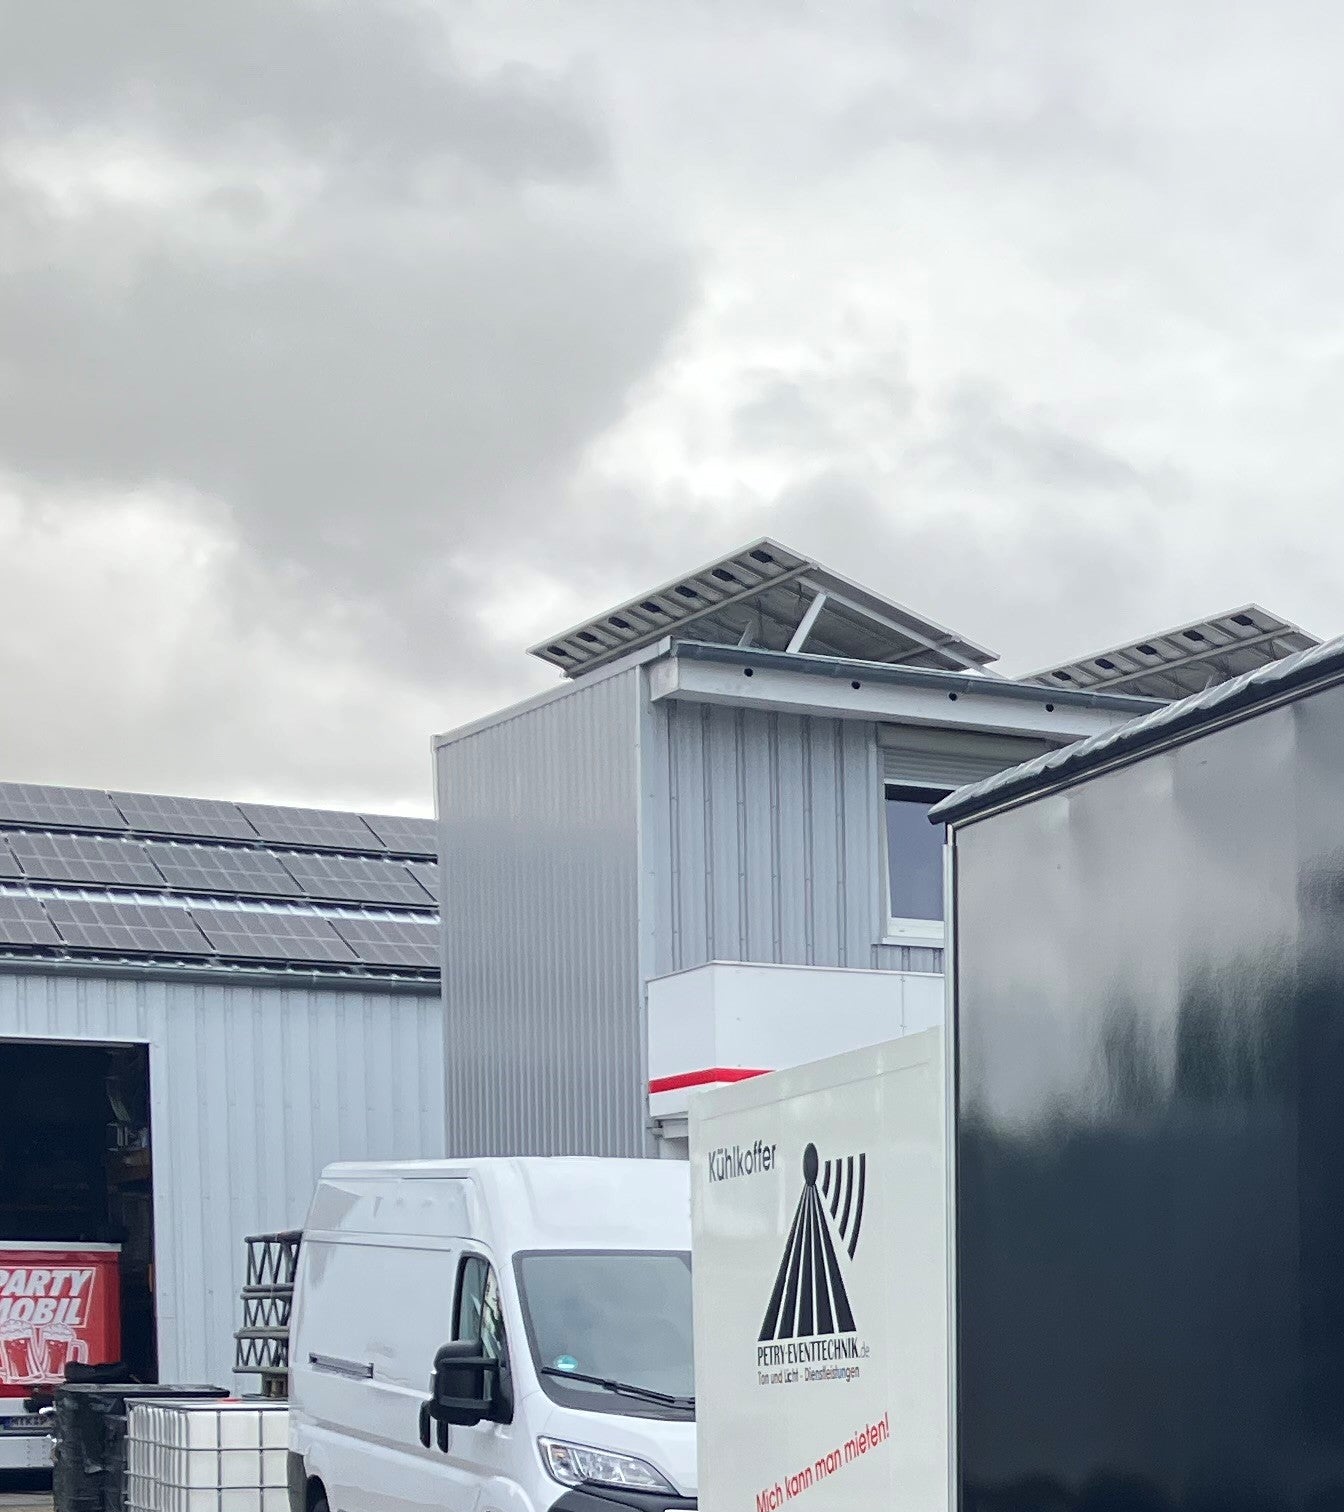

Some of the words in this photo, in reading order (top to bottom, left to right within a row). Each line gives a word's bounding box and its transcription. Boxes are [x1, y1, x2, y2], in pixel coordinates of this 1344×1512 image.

[708, 1139, 777, 1183] Kühlkoffer
[770, 1369, 783, 1384] und
[804, 1364, 860, 1382] Dienstleistungen
[784, 1466, 813, 1501] kann
[815, 1449, 843, 1482] man
[844, 1411, 890, 1463] mieten!
